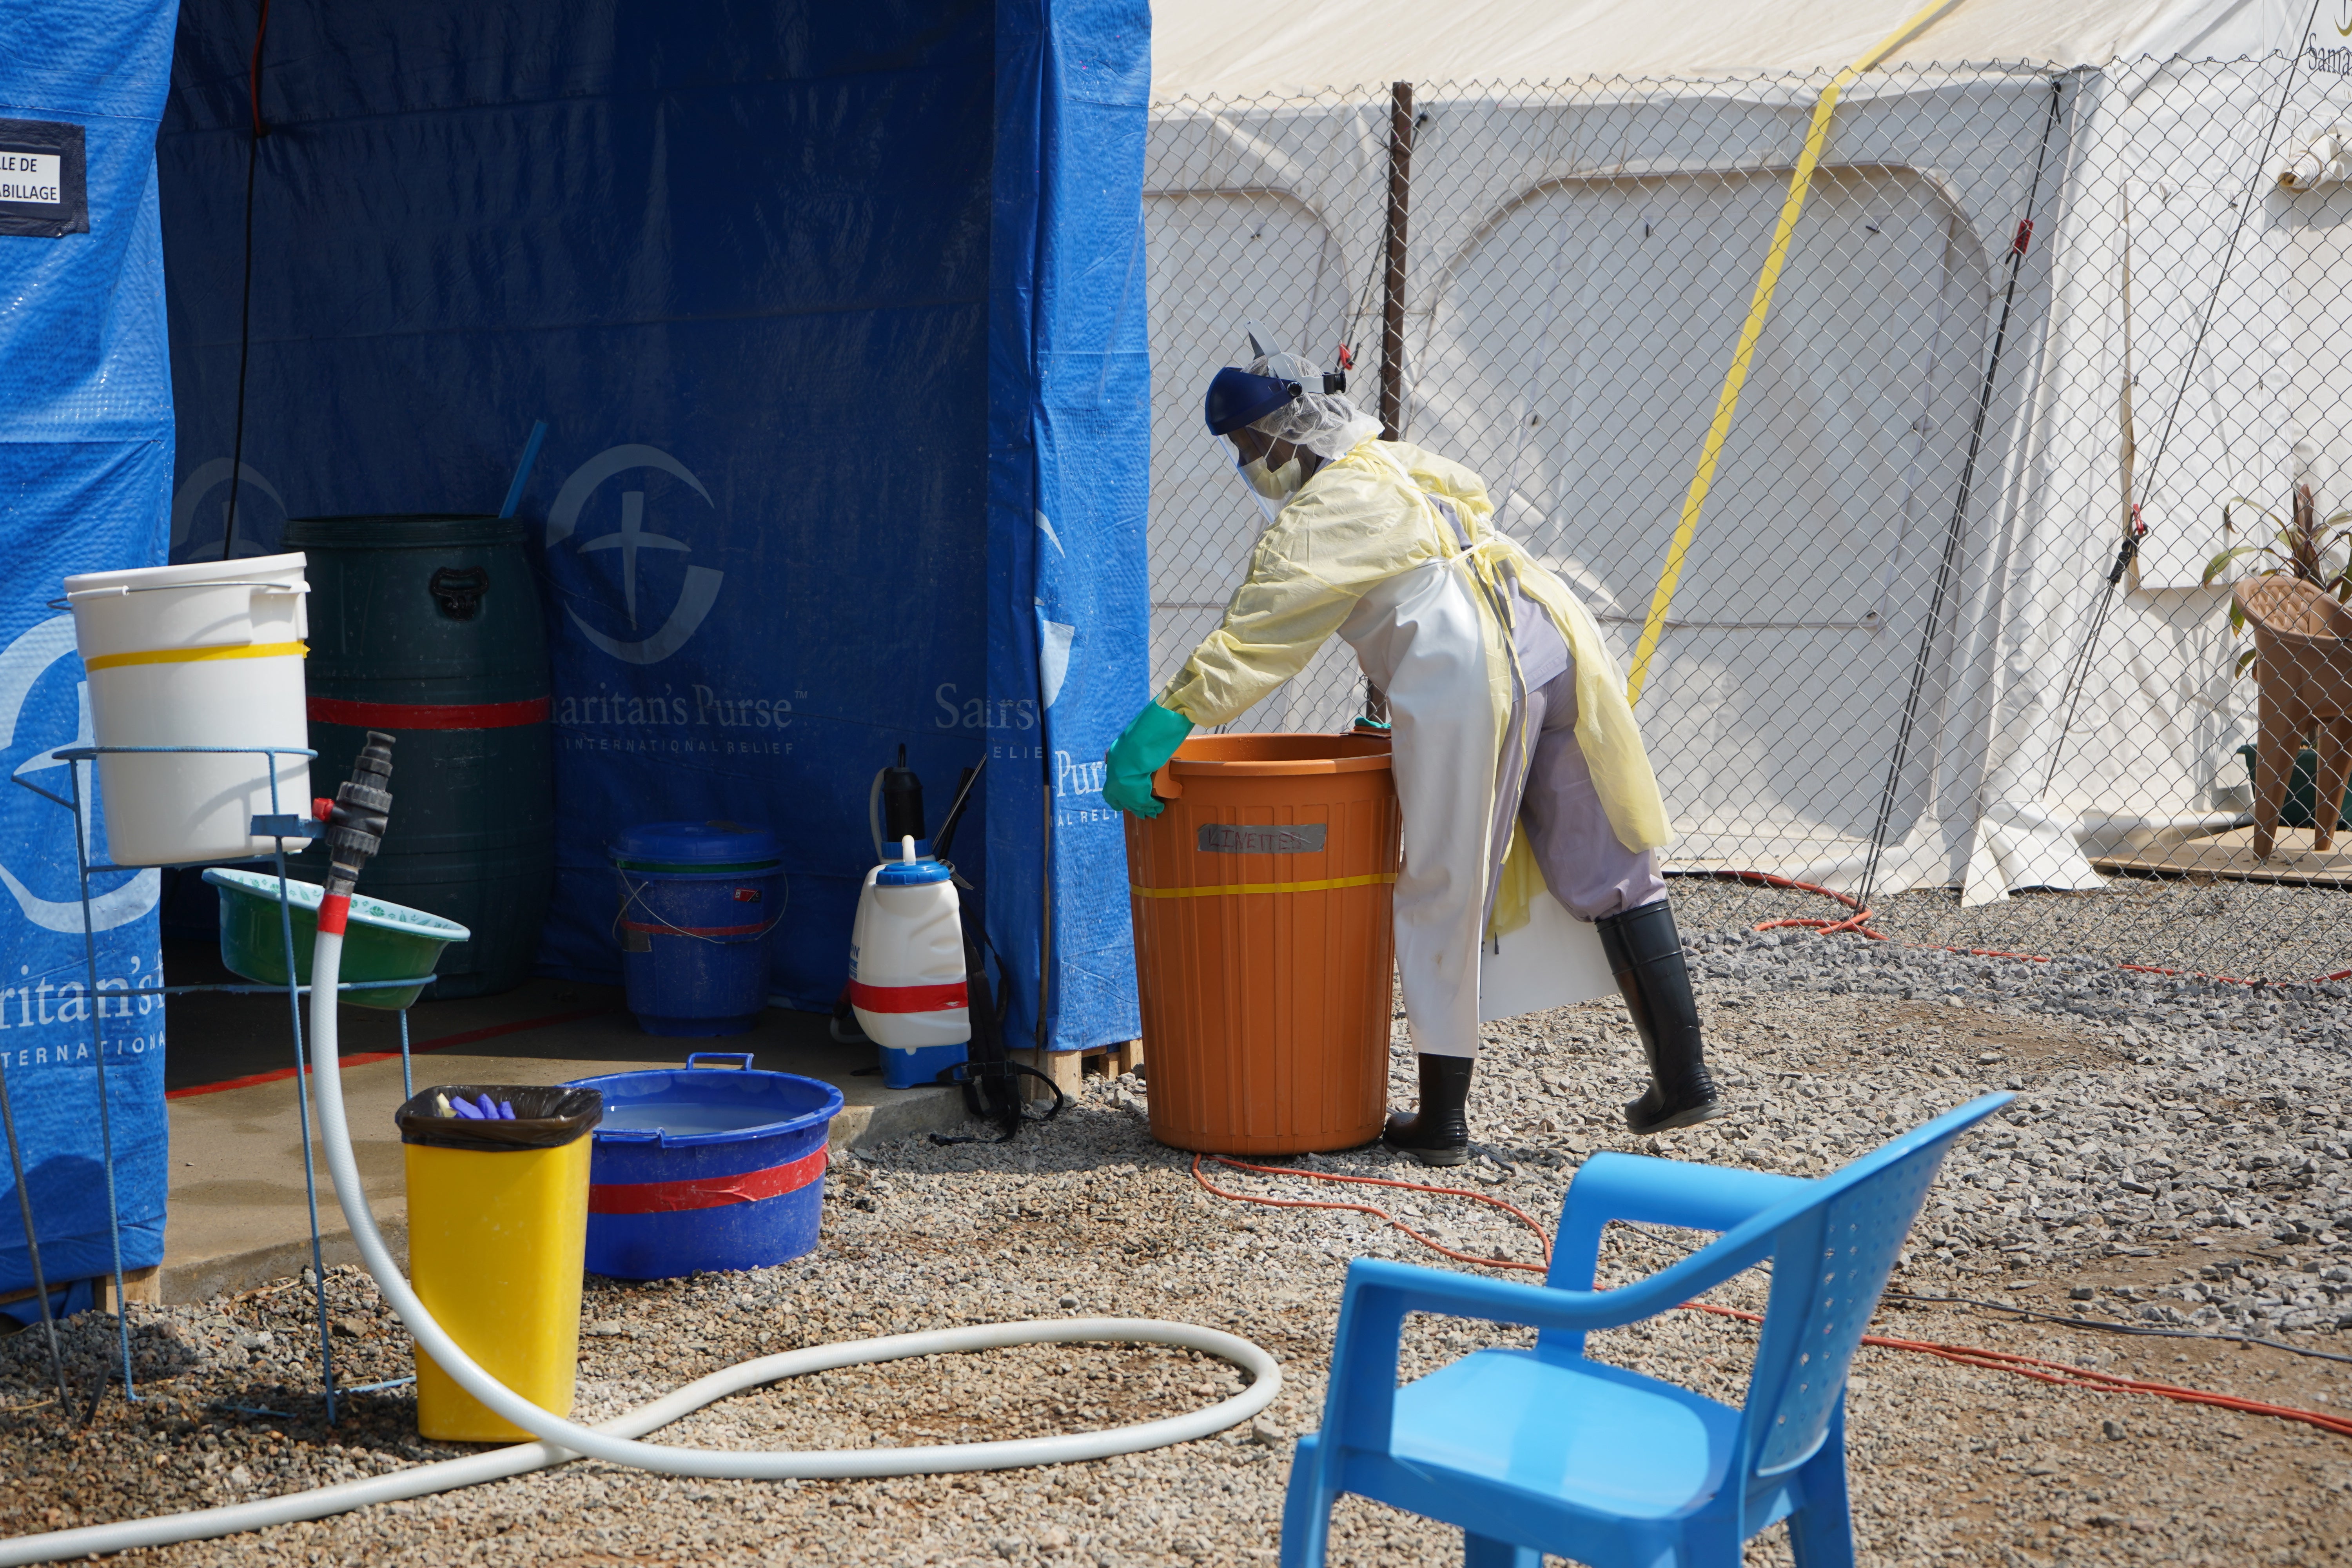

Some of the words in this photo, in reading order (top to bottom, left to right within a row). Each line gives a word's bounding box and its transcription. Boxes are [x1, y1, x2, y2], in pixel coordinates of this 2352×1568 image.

[2308, 33, 2352, 76] Sama
[0, 156, 16, 171] LE
[20, 158, 37, 172] DE
[0, 184, 57, 200] BILLAGE
[566, 739, 718, 752] INTERNATIONAL
[728, 741, 793, 754] RELIEF
[1055, 750, 1107, 797] Pur
